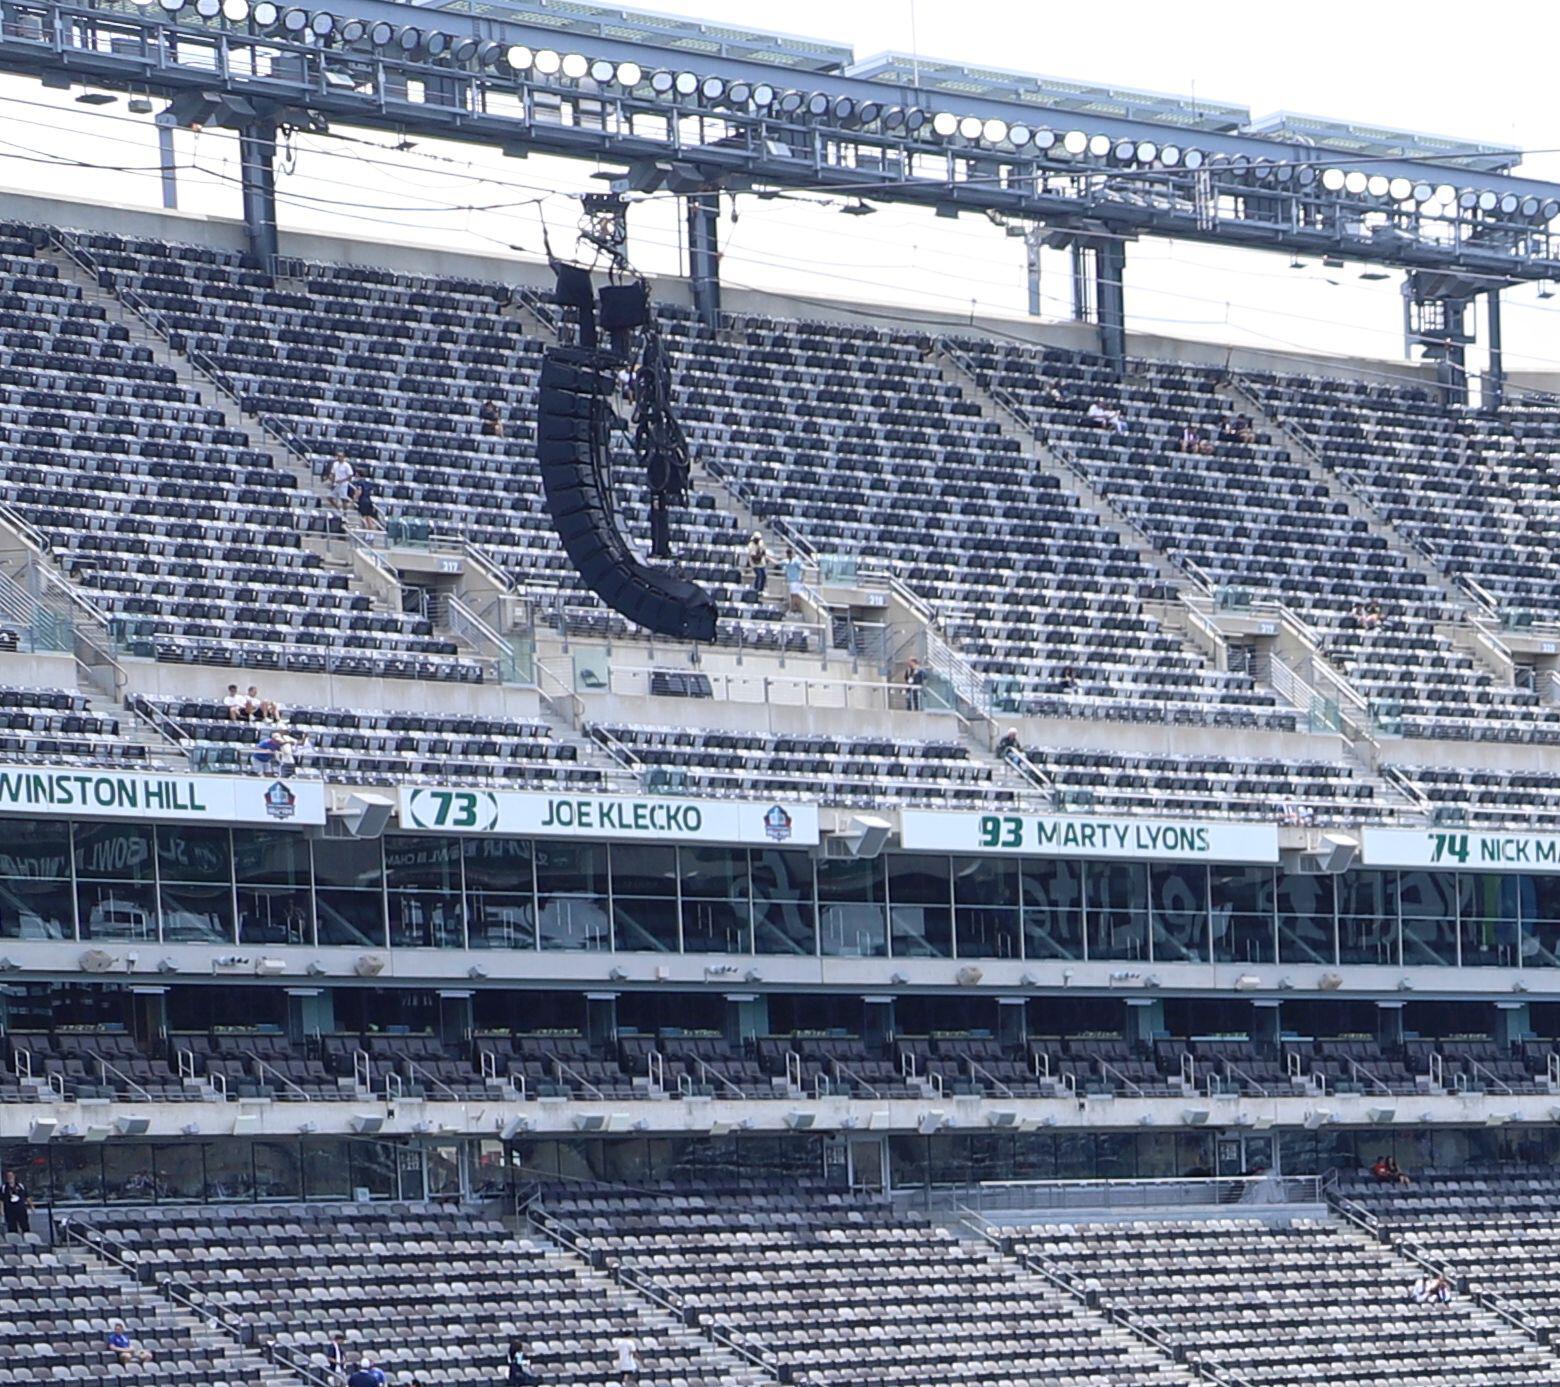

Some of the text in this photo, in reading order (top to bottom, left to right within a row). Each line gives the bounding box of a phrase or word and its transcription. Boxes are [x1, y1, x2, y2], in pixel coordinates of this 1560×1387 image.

[143, 779, 207, 812] HILL
[431, 792, 703, 835] 73 JOE KLECKO
[979, 813, 1211, 854] 93 MARTY LYONS
[1428, 832, 1470, 865] 74
[1481, 837, 1530, 864] NICK
